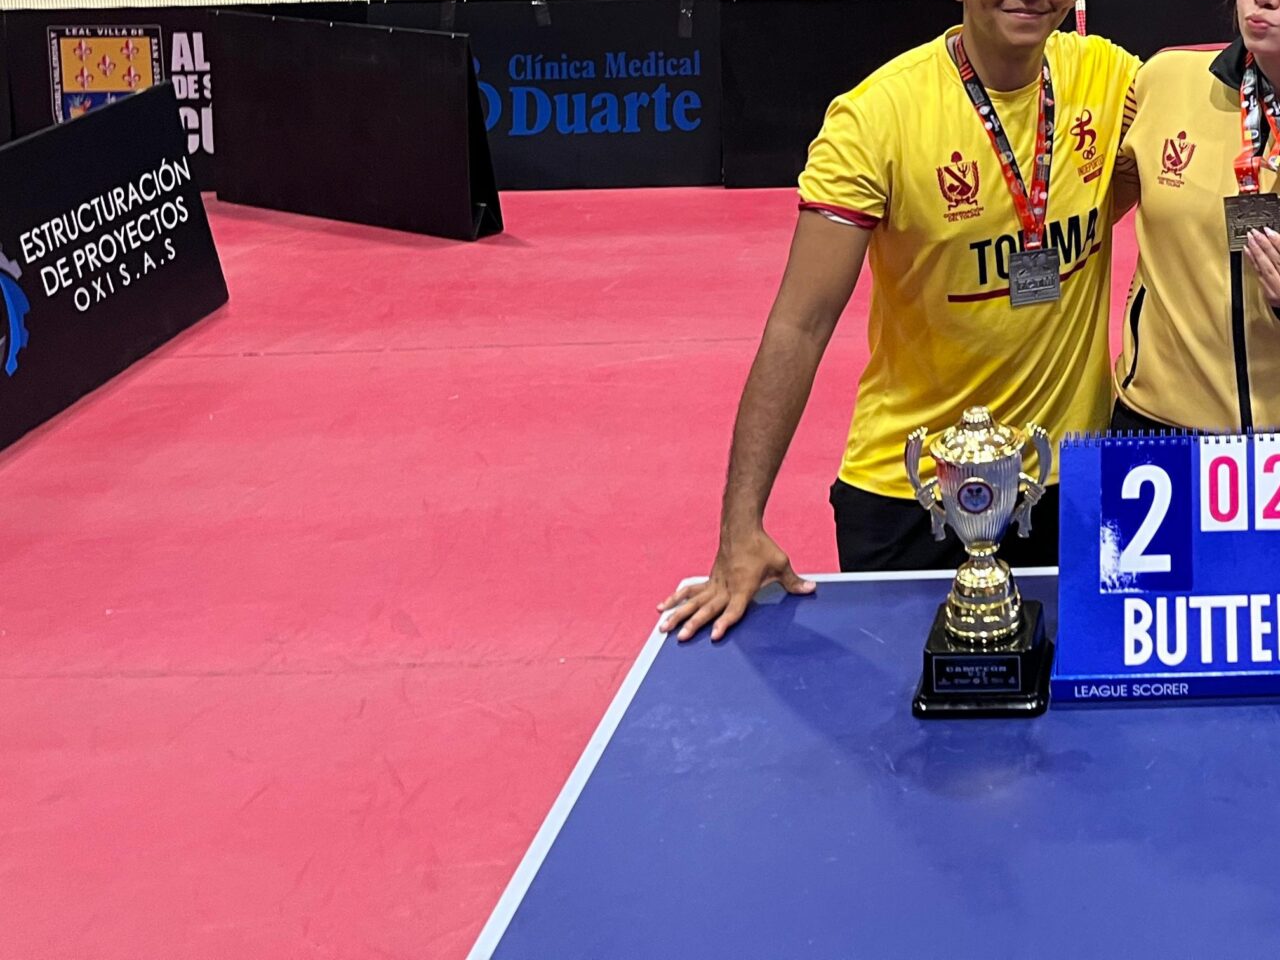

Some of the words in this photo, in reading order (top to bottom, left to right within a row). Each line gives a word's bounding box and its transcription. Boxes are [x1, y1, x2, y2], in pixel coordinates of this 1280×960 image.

[65, 27, 92, 36] LEAL
[97, 27, 127, 36] VILLA
[172, 74, 200, 100] DE
[508, 53, 596, 81] Clínica
[604, 50, 701, 78] Medical
[508, 83, 702, 136] Duarte
[20, 156, 191, 264] ESTRUCTURACIÓN
[40, 257, 73, 297] DE
[73, 196, 188, 279] PROYECTOS
[969, 207, 1099, 286] TOMA
[1119, 464, 1173, 573] 2
[1208, 456, 1240, 523] 0
[1074, 684, 1128, 699] LEAGUE
[1132, 682, 1189, 698] SCORER
